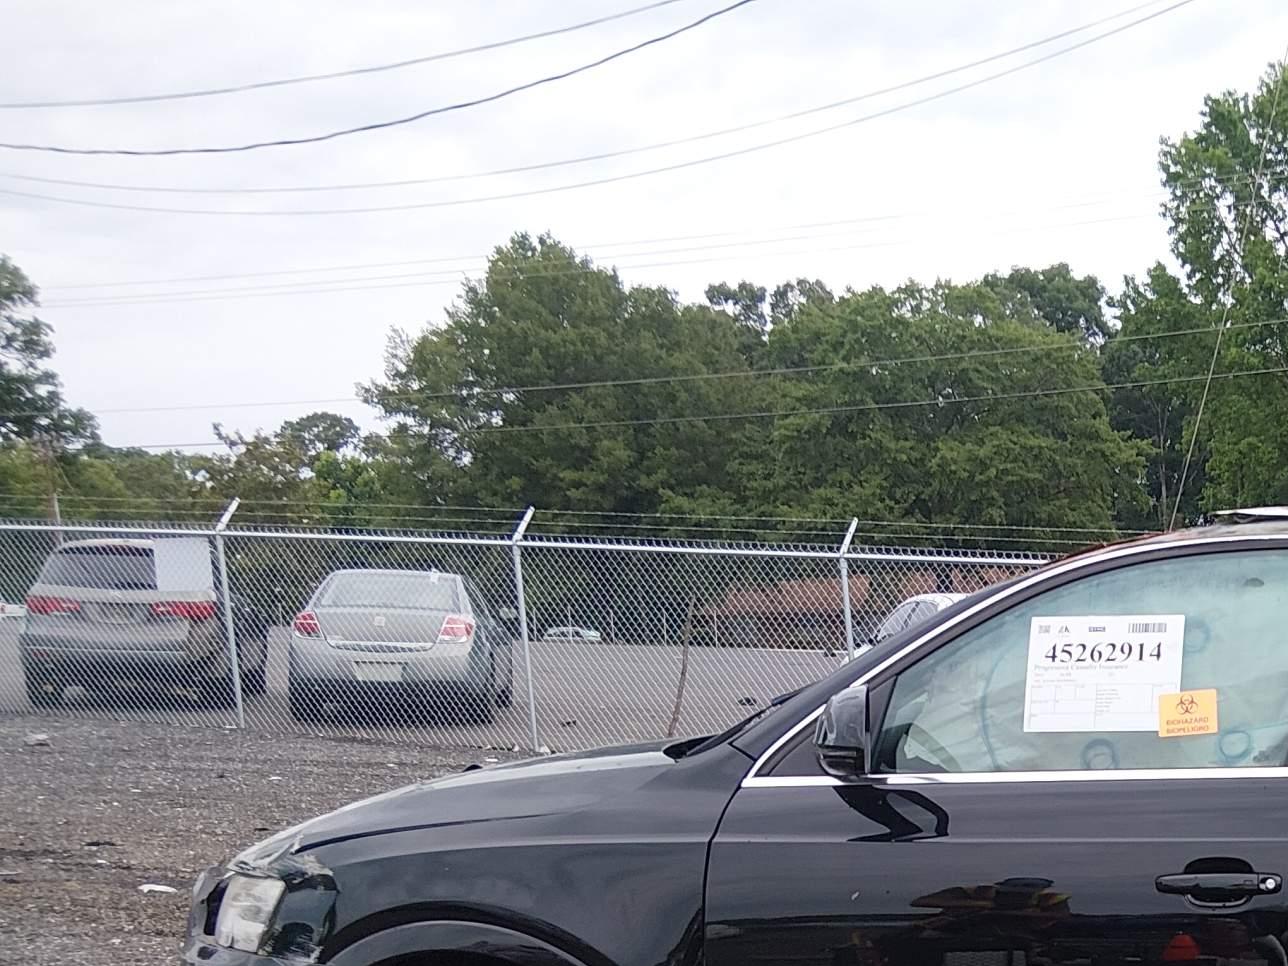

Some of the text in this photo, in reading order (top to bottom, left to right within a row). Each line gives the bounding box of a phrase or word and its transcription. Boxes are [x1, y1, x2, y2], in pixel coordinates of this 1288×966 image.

[1044, 641, 1162, 663] 45262914
[1166, 716, 1209, 726] BIOHAZARD
[1166, 725, 1209, 734] BIOPELIGRO
